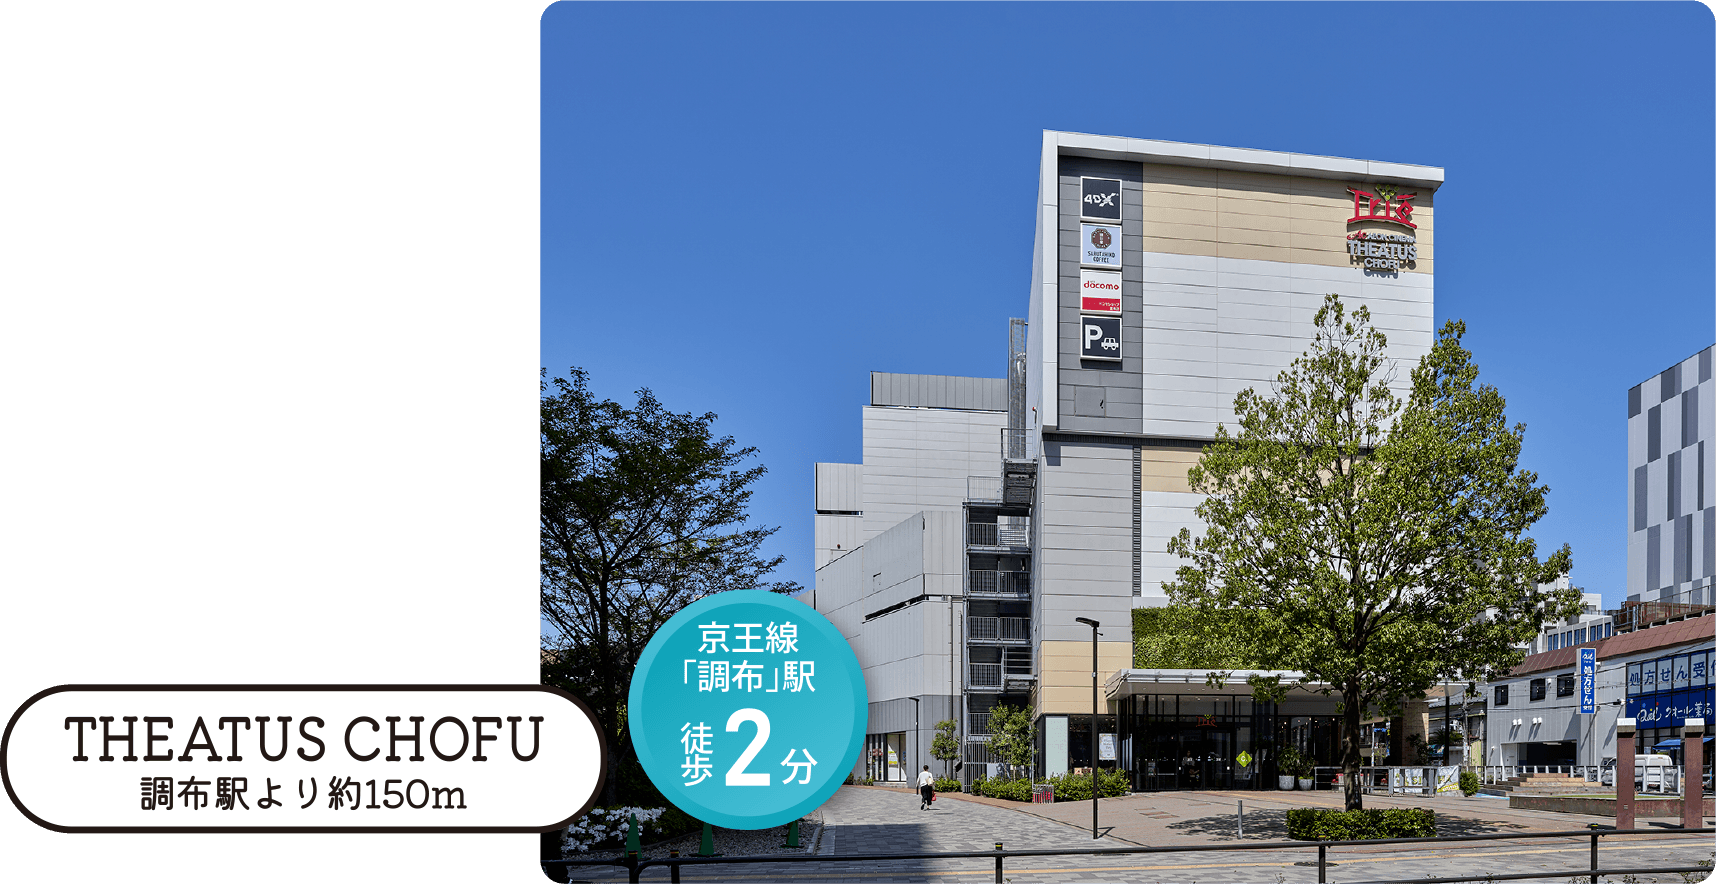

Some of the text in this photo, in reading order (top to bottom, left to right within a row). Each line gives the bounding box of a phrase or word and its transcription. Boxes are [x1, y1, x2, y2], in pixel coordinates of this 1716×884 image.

[1348, 240, 1417, 261] THEATUS
[1364, 257, 1400, 269] CHOFU
[1083, 280, 1119, 290] docomo
[1085, 324, 1103, 349] P
